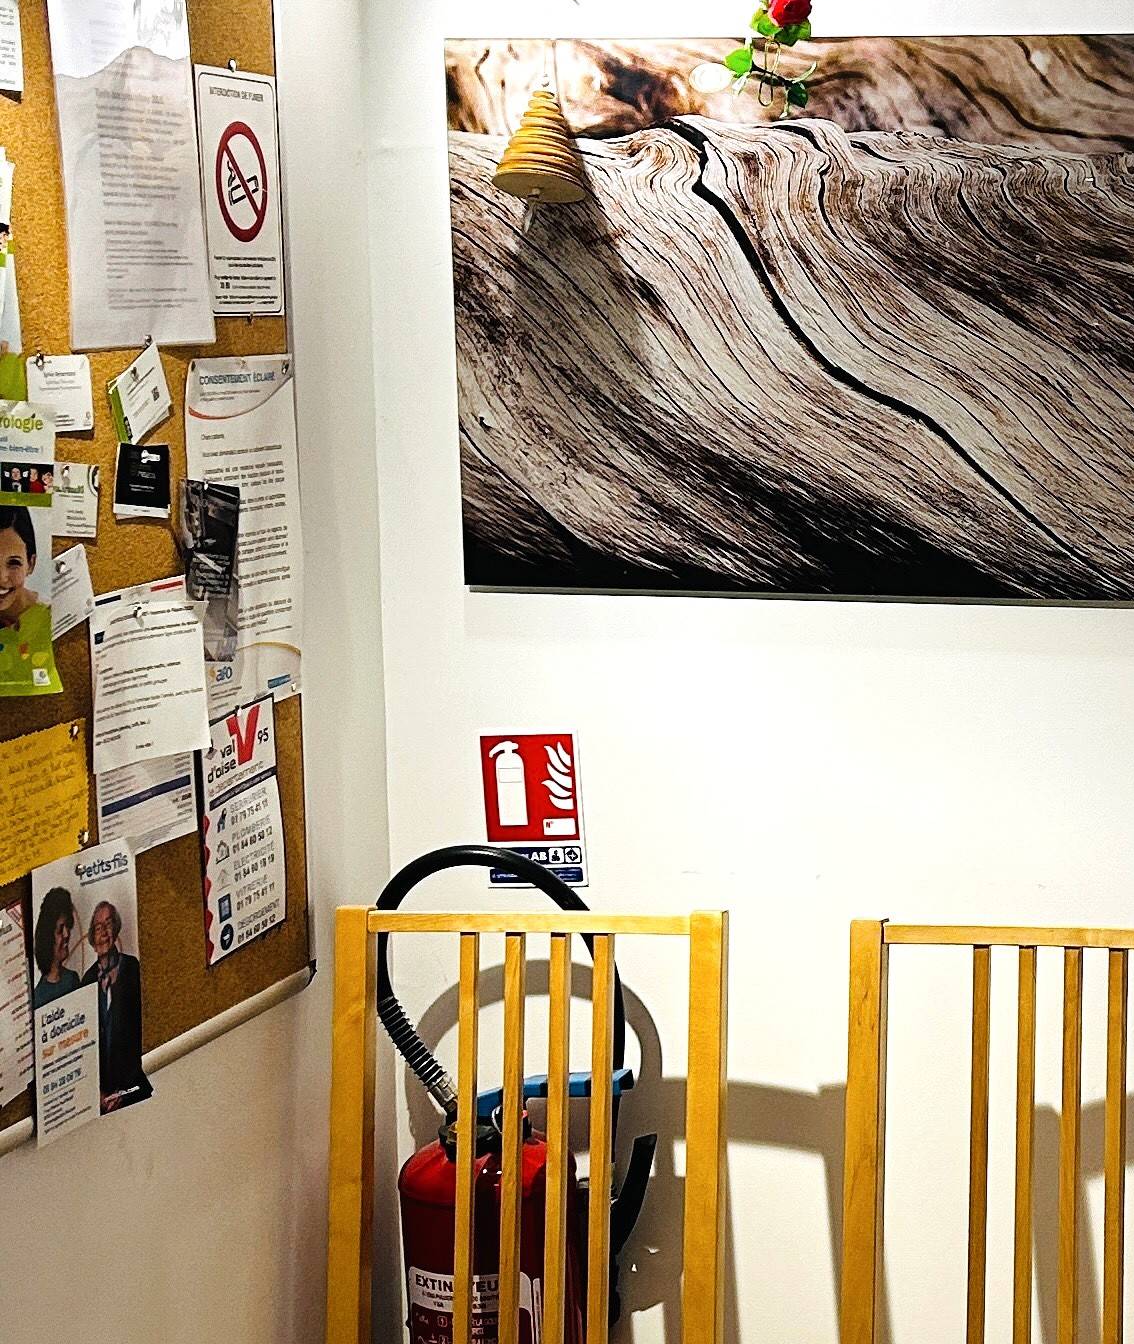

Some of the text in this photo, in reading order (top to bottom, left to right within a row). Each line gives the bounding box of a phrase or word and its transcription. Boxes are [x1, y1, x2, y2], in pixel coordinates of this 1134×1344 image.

[200, 373, 252, 386] CONSENTEMENT
[220, 728, 269, 759] val 95
[207, 758, 237, 784] d'oise
[41, 1007, 65, 1028] L'aide
[50, 1013, 86, 1039] domicile
